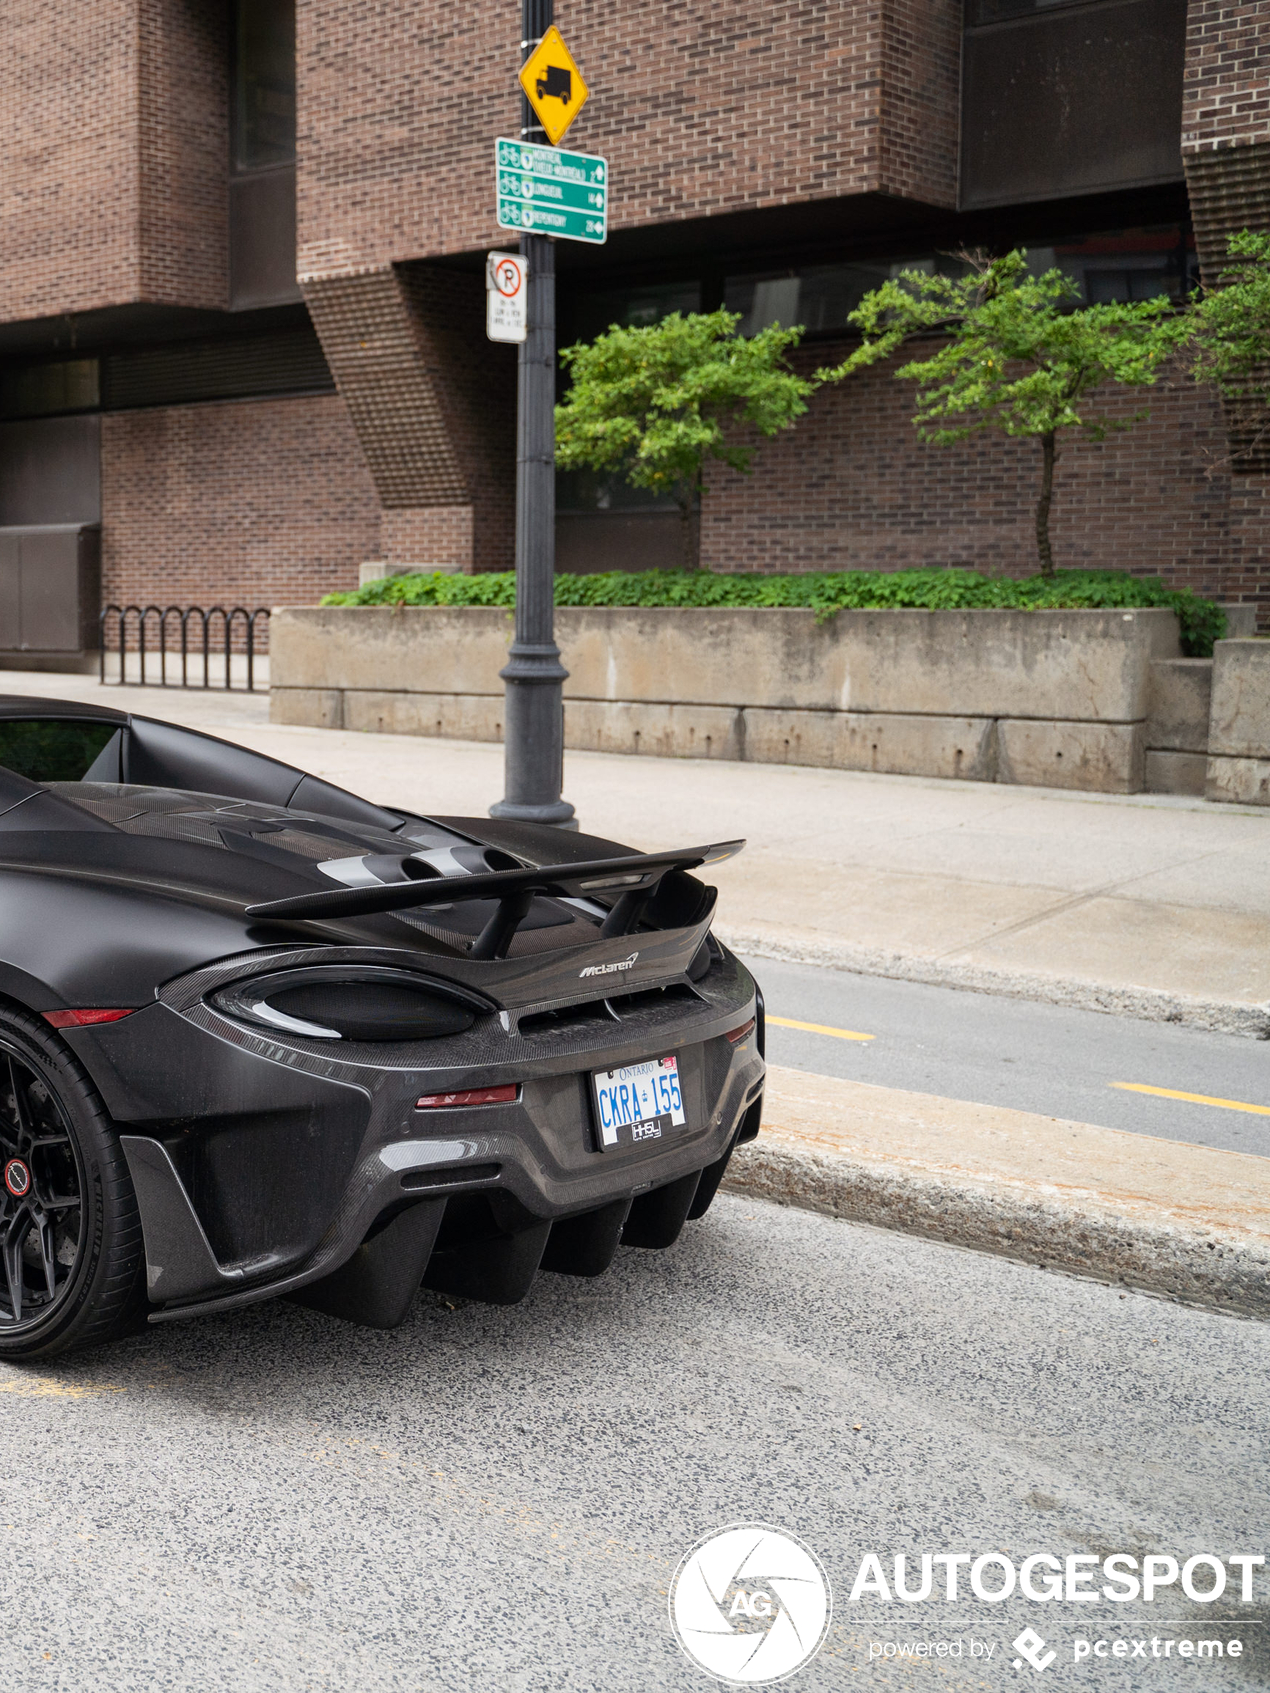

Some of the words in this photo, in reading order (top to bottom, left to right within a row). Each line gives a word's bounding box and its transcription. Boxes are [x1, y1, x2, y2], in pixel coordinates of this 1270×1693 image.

[579, 952, 639, 978] McLaren
[599, 1083, 642, 1128] CKRA
[651, 1073, 681, 1115] 155
